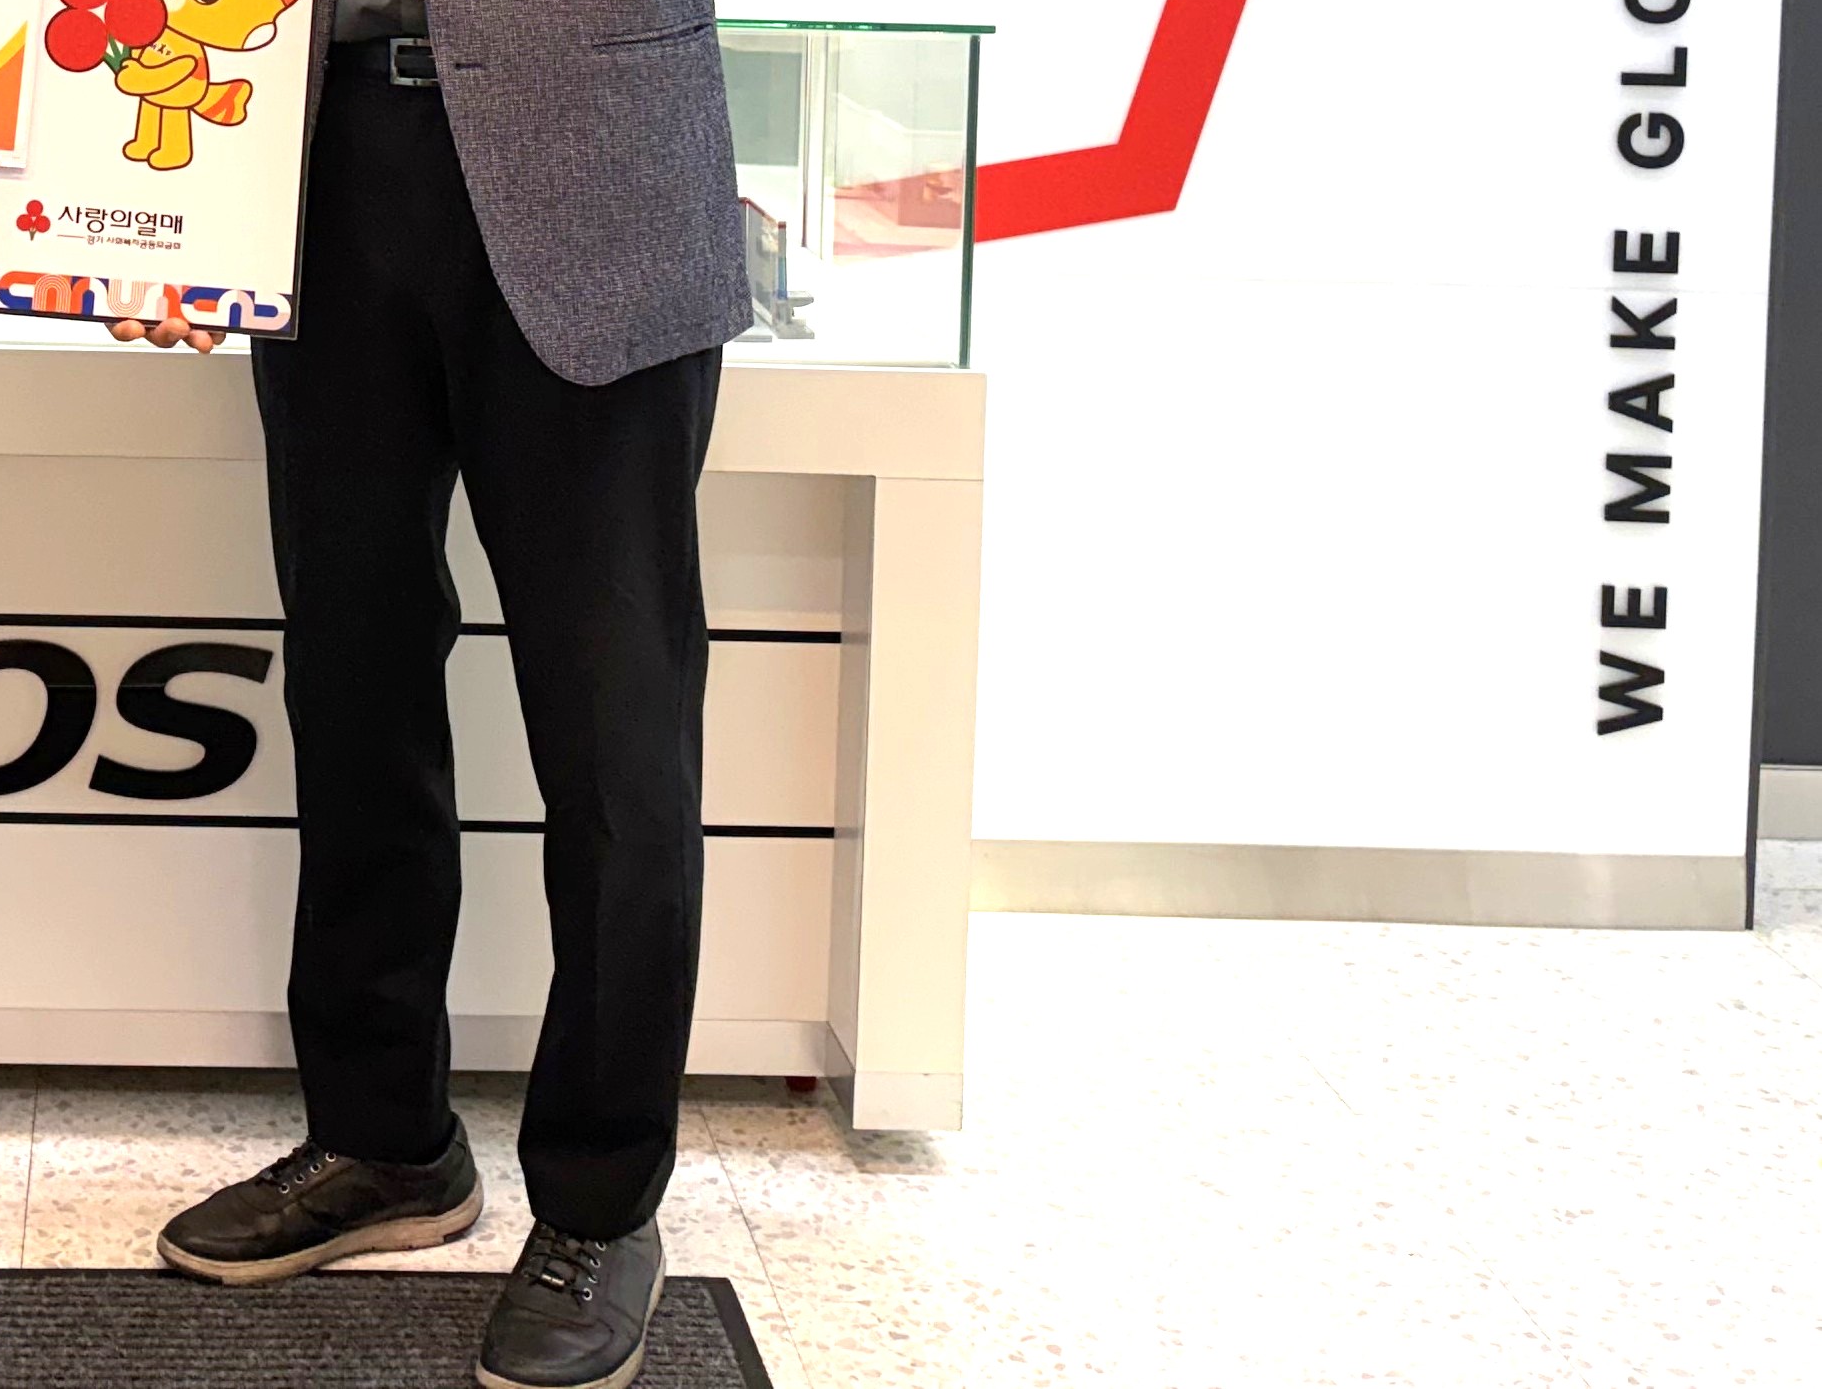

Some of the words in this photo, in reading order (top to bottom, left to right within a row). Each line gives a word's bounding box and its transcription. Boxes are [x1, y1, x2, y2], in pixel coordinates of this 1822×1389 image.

[58, 206, 183, 237] 사랑의열매
[1604, 229, 1680, 524] MAKE
[1597, 583, 1668, 736] WE
